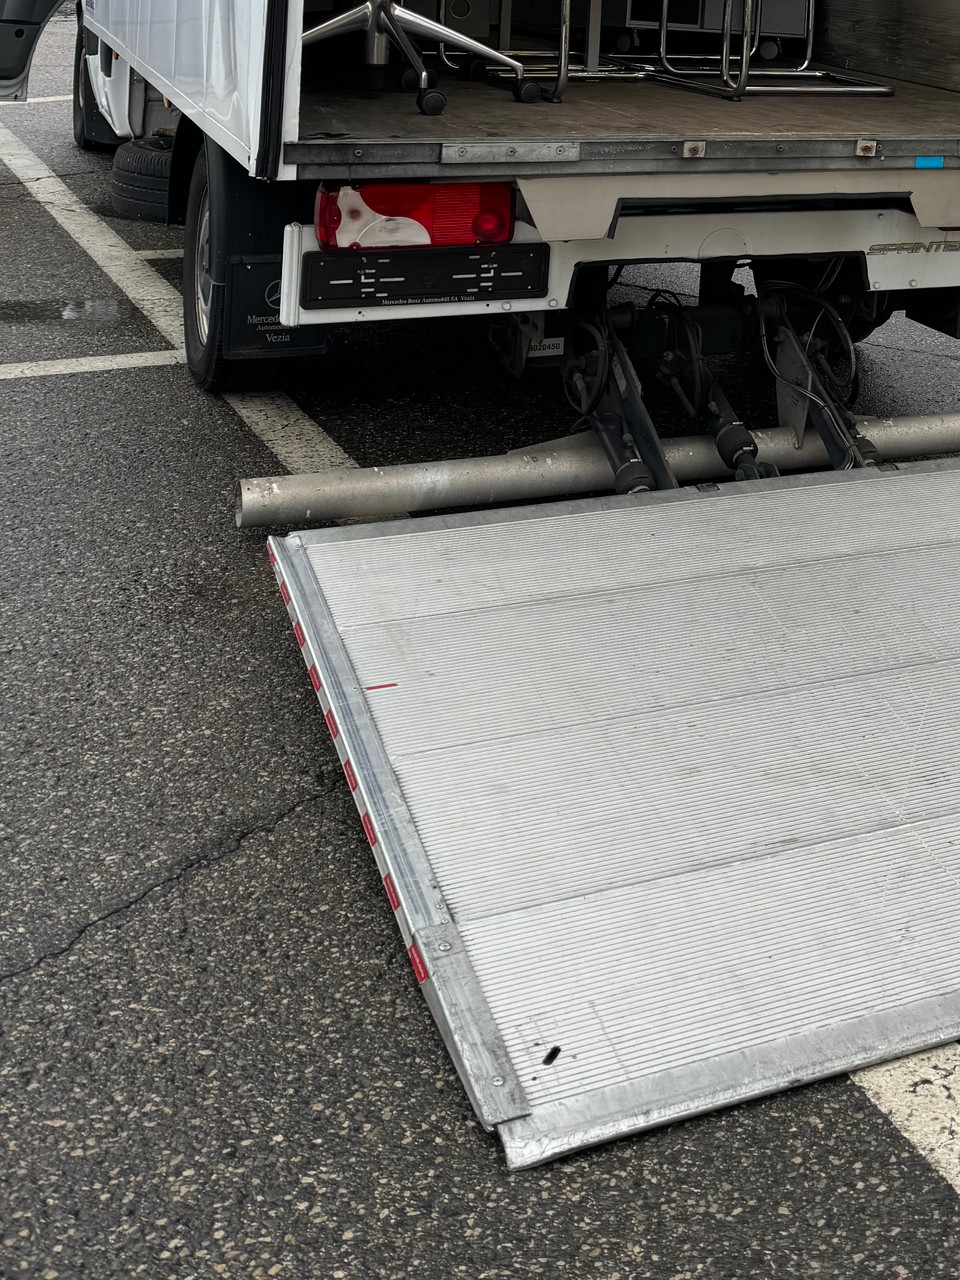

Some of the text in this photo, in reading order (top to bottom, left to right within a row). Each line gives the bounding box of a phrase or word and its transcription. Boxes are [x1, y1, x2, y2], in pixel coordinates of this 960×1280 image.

[247, 313, 281, 324] Merced
[266, 333, 290, 342] Vezia
[528, 342, 561, 352] 8020450
